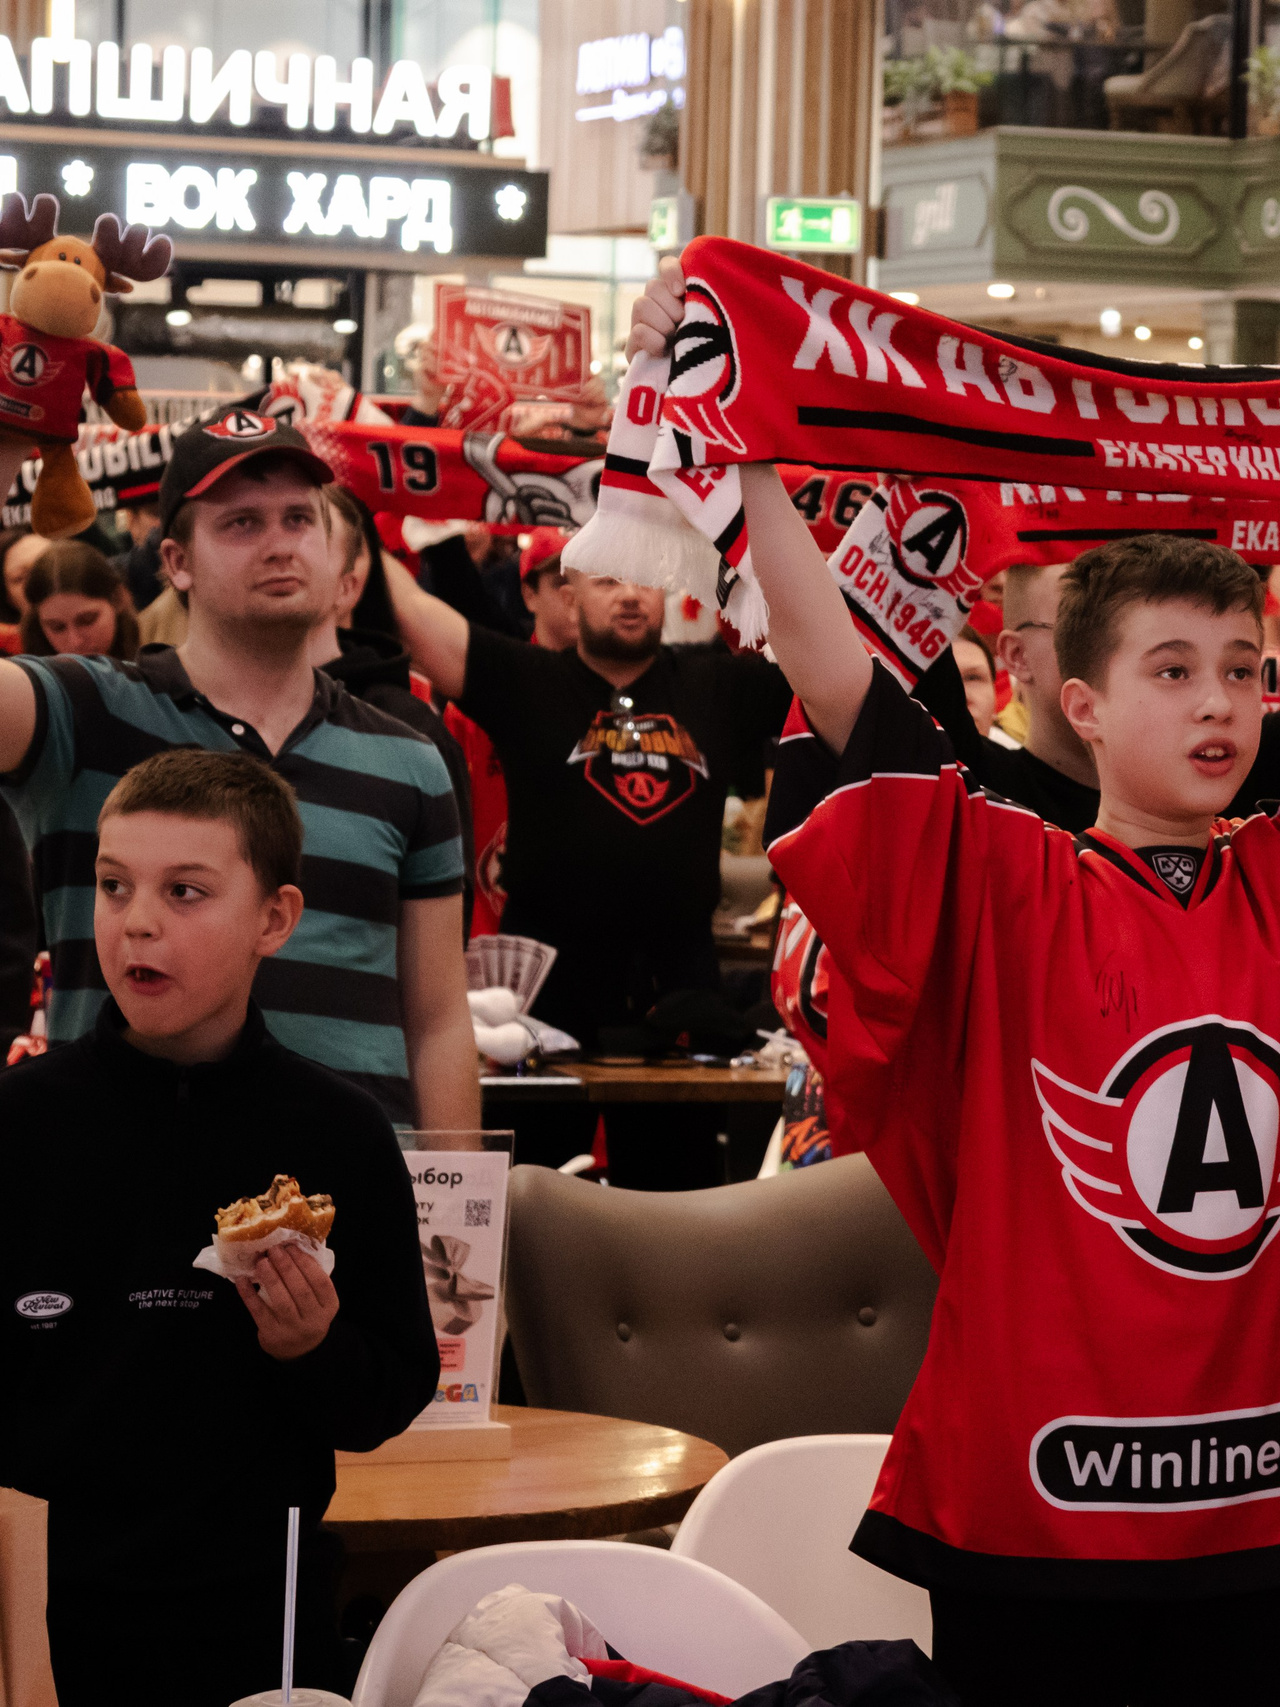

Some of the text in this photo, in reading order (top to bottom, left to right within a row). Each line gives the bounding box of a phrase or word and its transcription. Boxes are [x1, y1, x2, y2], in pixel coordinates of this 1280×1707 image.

[125, 162, 453, 254] ВОК ХАРД
[781, 275, 927, 389] ХК
[367, 441, 438, 494] 19
[790, 474, 873, 531] 46
[839, 544, 947, 659] ОСН.1946
[22, 1300, 65, 1313] Revival
[128, 1289, 215, 1302] CREATIVE FUTURE
[138, 1299, 200, 1309] the next stop
[1063, 1436, 1280, 1488] Winline
